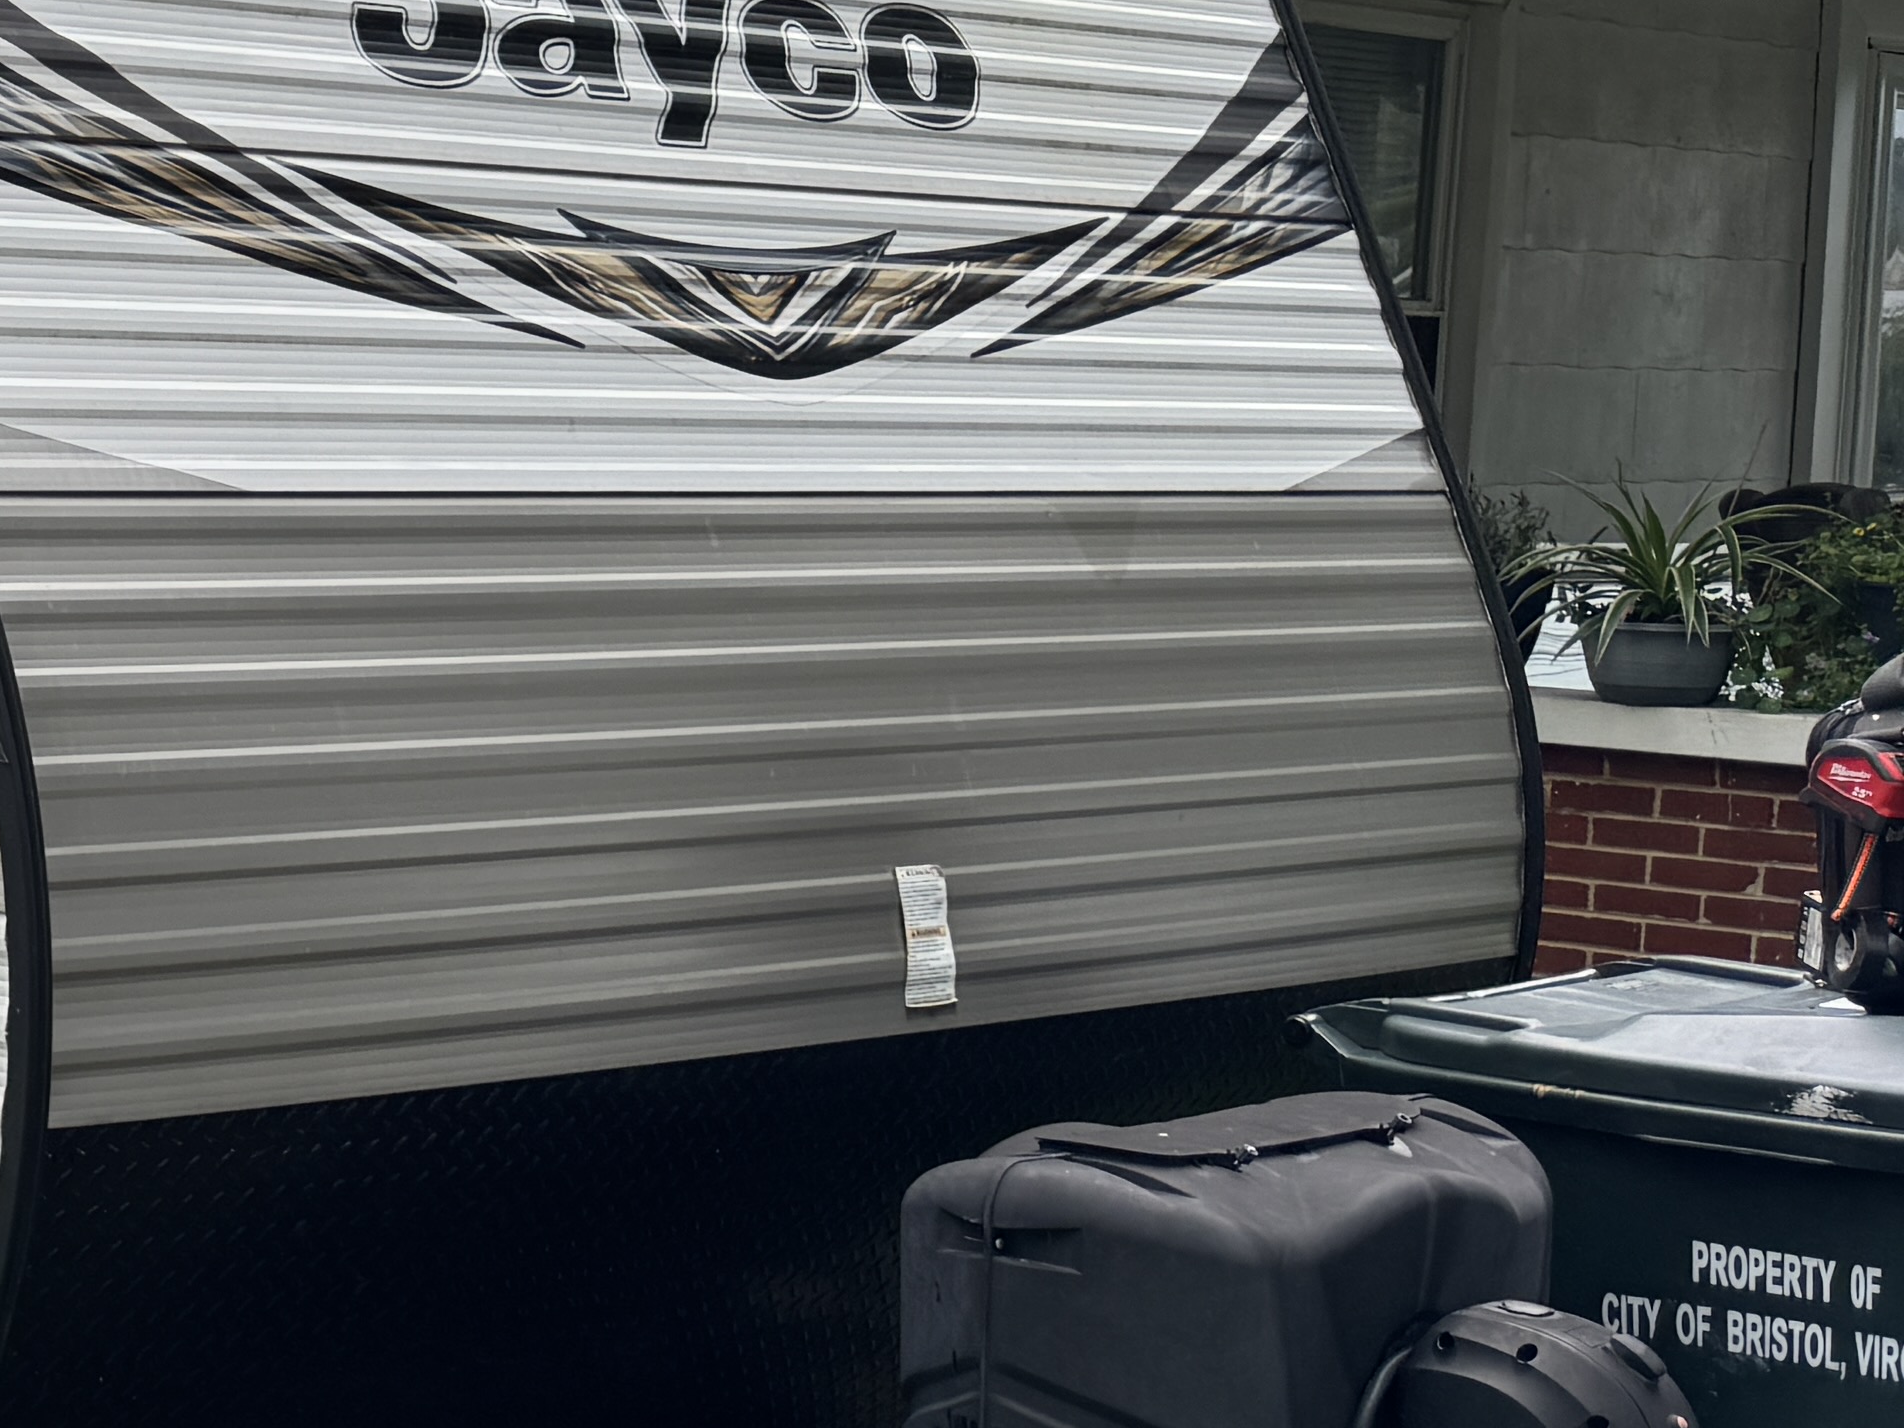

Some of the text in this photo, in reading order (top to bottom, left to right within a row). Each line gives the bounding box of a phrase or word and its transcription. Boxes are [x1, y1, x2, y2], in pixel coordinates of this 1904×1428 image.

[1691, 1239, 1883, 1311] PROPERTY OF
[1601, 1291, 1904, 1382] CITY OF BRISTOL, VIR
